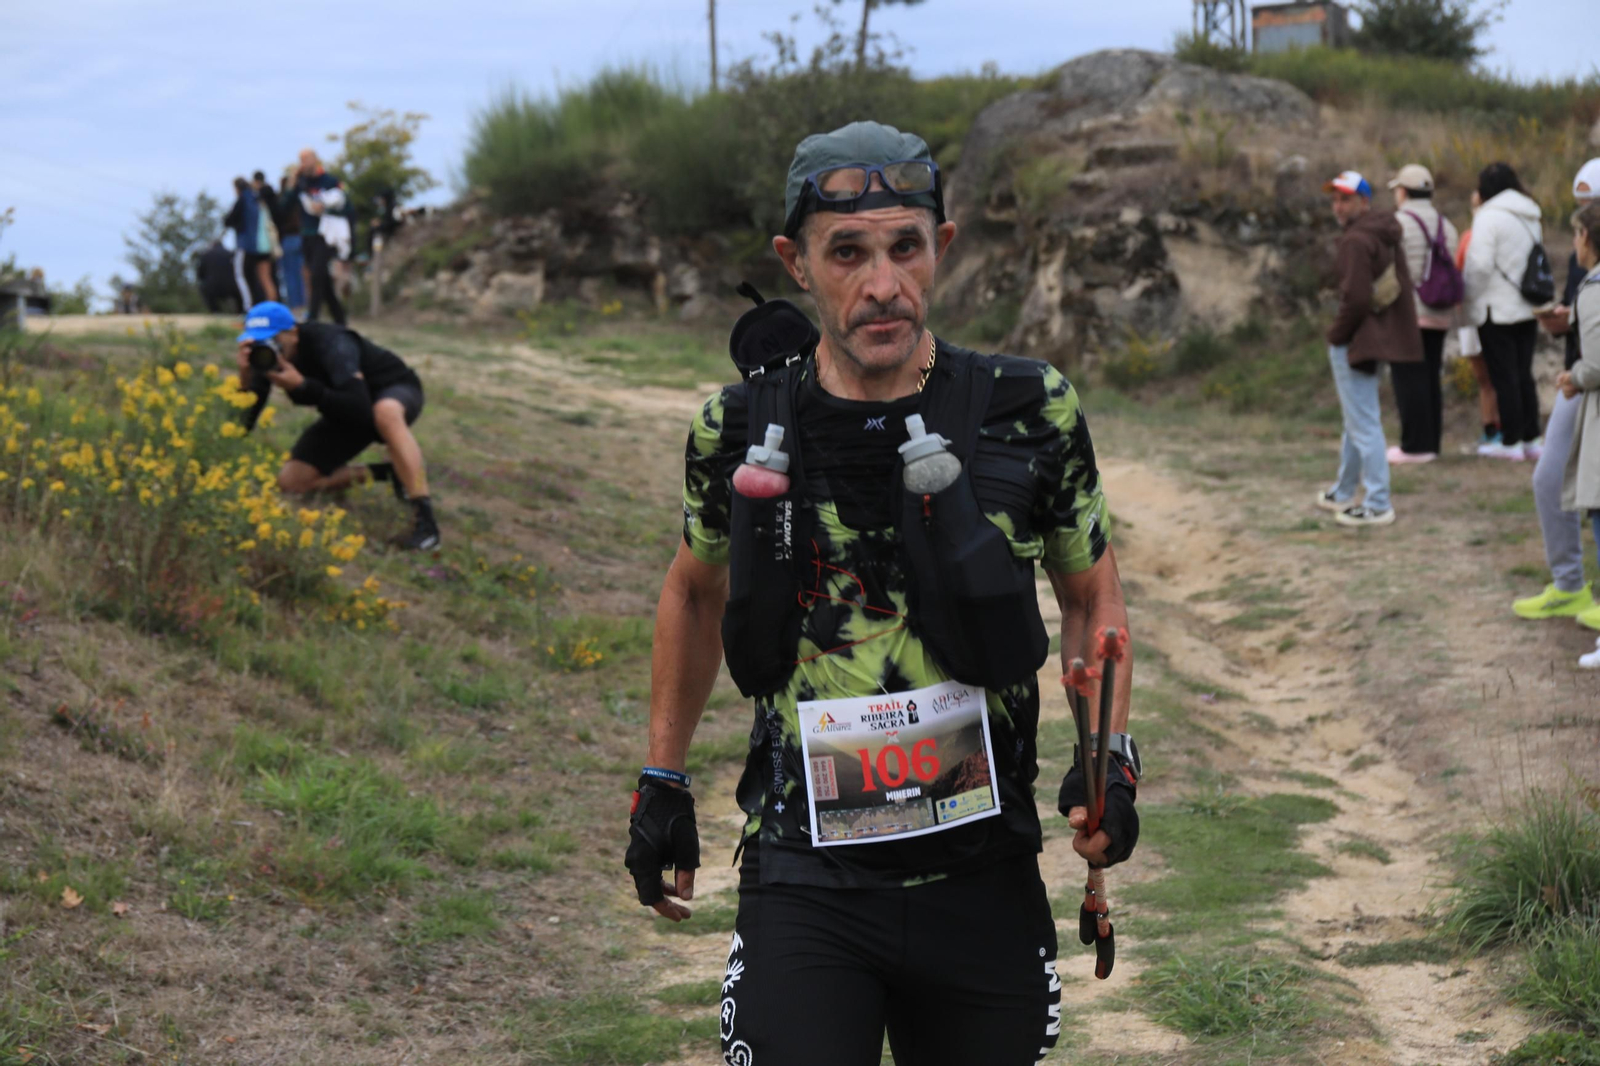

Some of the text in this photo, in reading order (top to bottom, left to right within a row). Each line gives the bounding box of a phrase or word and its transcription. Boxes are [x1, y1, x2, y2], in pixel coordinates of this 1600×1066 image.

[868, 701, 904, 713] TRAIL
[860, 711, 905, 723] RIBEIRA
[870, 720, 905, 732] SACRA
[857, 738, 941, 792] 106
[772, 752, 785, 795] SWISS
[886, 786, 921, 802] MINERIN
